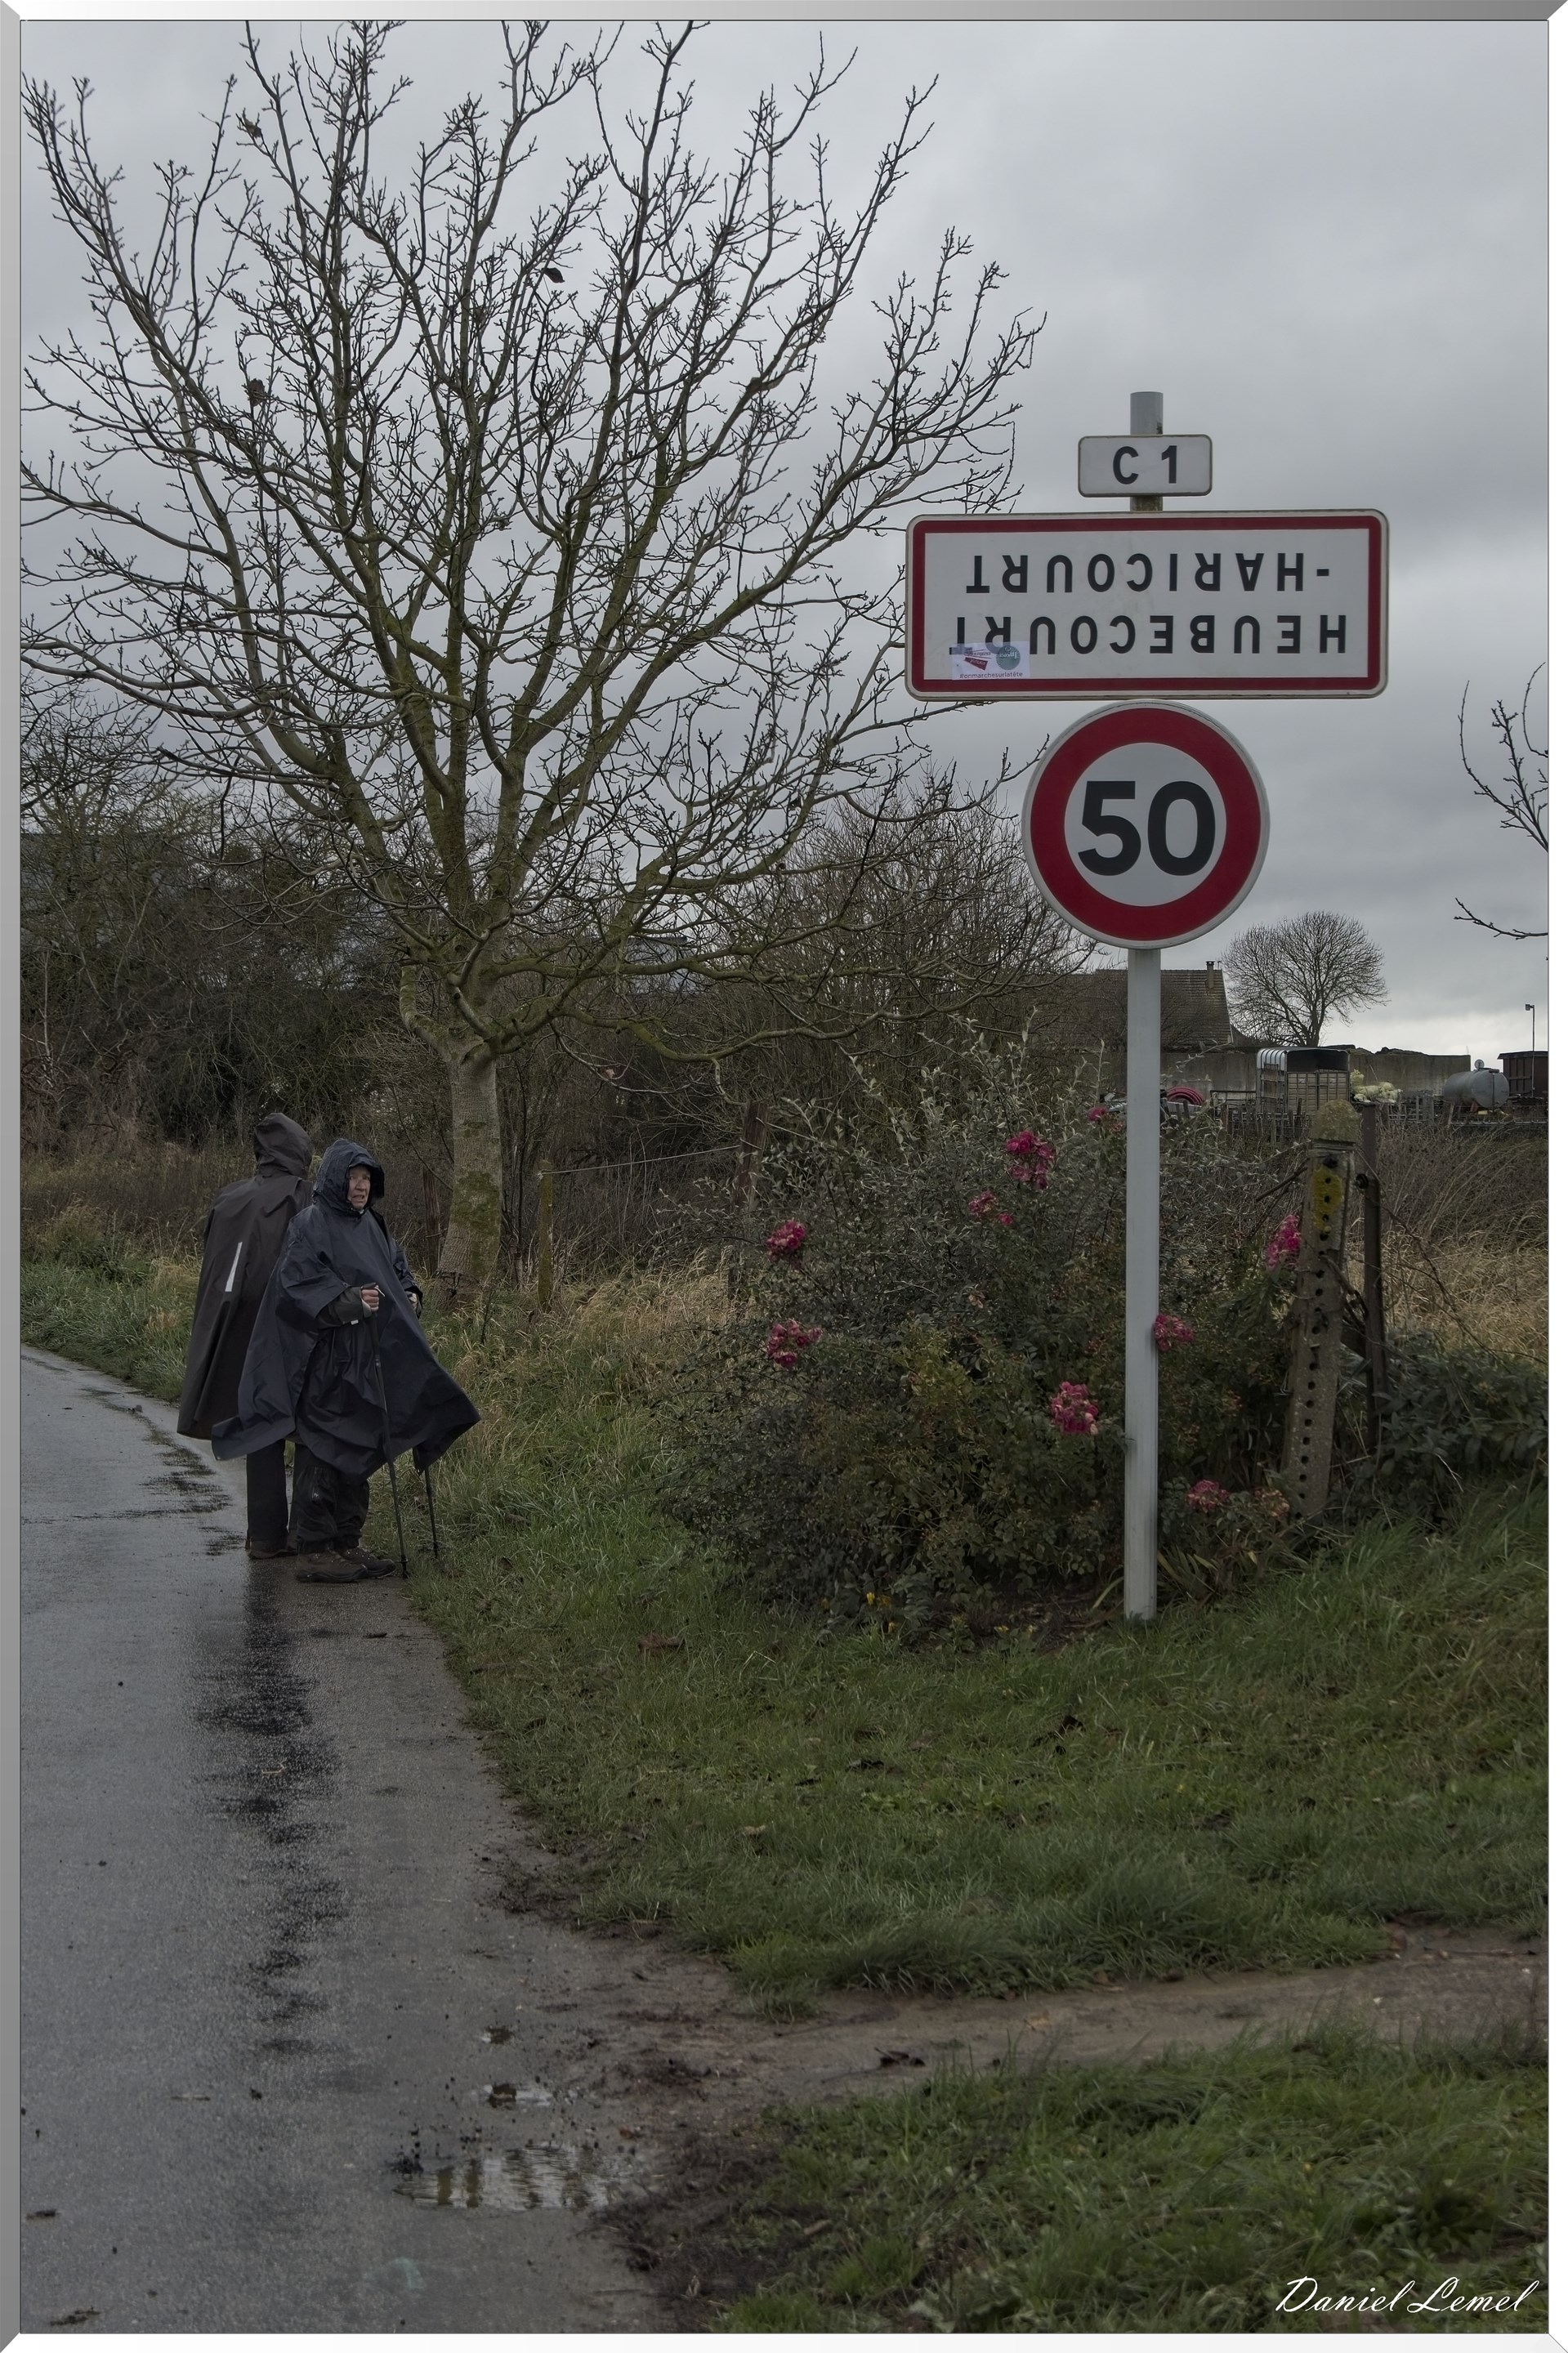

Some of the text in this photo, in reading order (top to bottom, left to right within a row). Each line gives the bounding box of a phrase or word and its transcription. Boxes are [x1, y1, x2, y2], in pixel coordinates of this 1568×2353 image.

[1112, 444, 1177, 484] C 1
[966, 552, 1330, 594] -HARICOURT
[949, 614, 1347, 655] HEUBECOURT
[959, 671, 1023, 679] #onmarchesurlatête
[1077, 780, 1217, 877] 50
